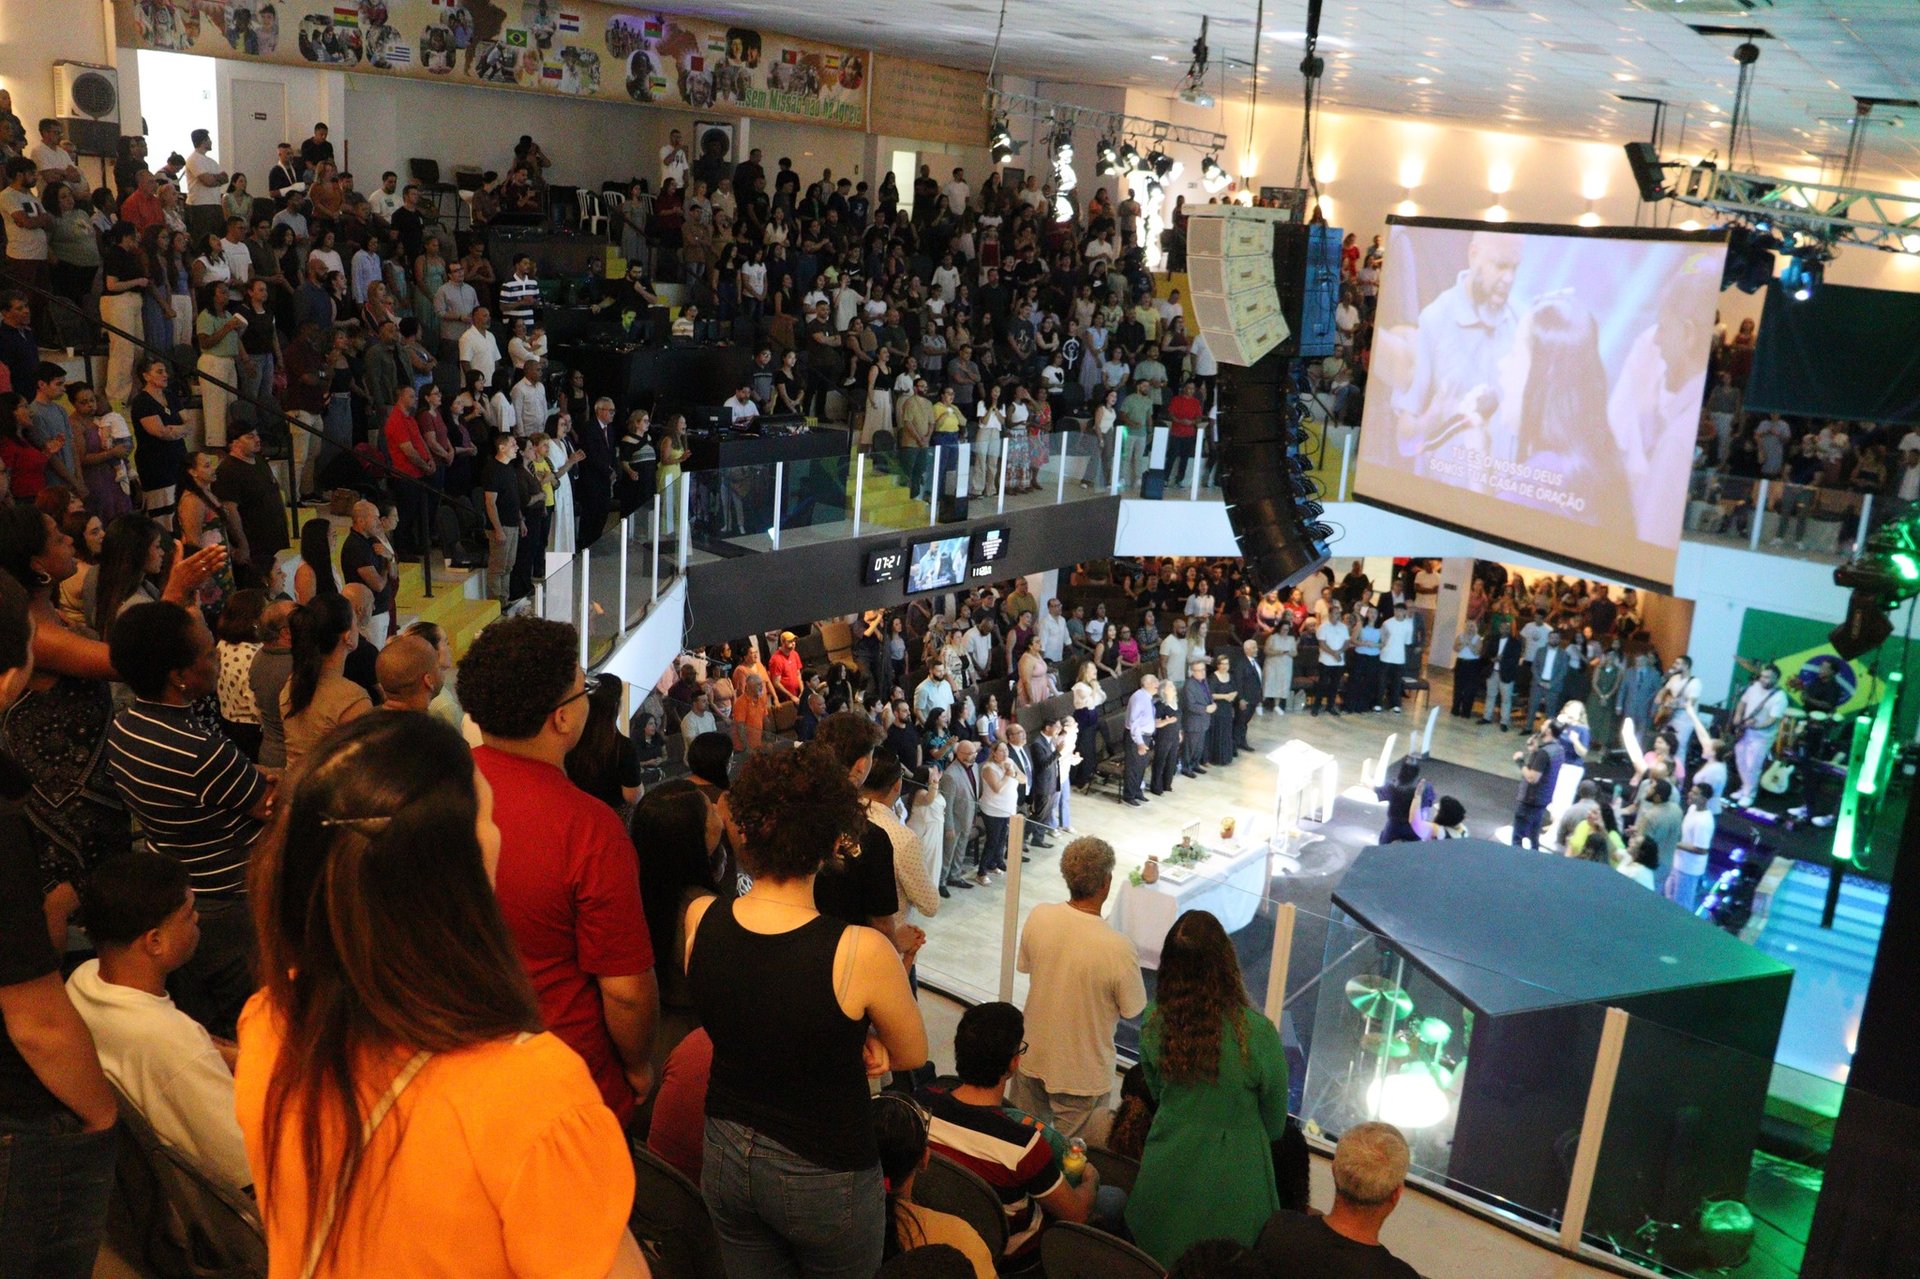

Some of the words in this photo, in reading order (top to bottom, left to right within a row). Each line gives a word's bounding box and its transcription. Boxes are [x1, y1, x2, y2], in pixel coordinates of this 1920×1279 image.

[1429, 459, 1464, 478] SOMOS
[1467, 467, 1488, 485] TUA
[1489, 472, 1518, 493] CASA
[1519, 482, 1534, 498] DE
[1535, 487, 1586, 513] ORAÇÃO
[1452, 446, 1465, 460] TU
[1484, 456, 1492, 468] O
[1493, 457, 1531, 479] NOSSO
[1532, 467, 1563, 486] DEUS
[874, 554, 901, 571] 07:21
